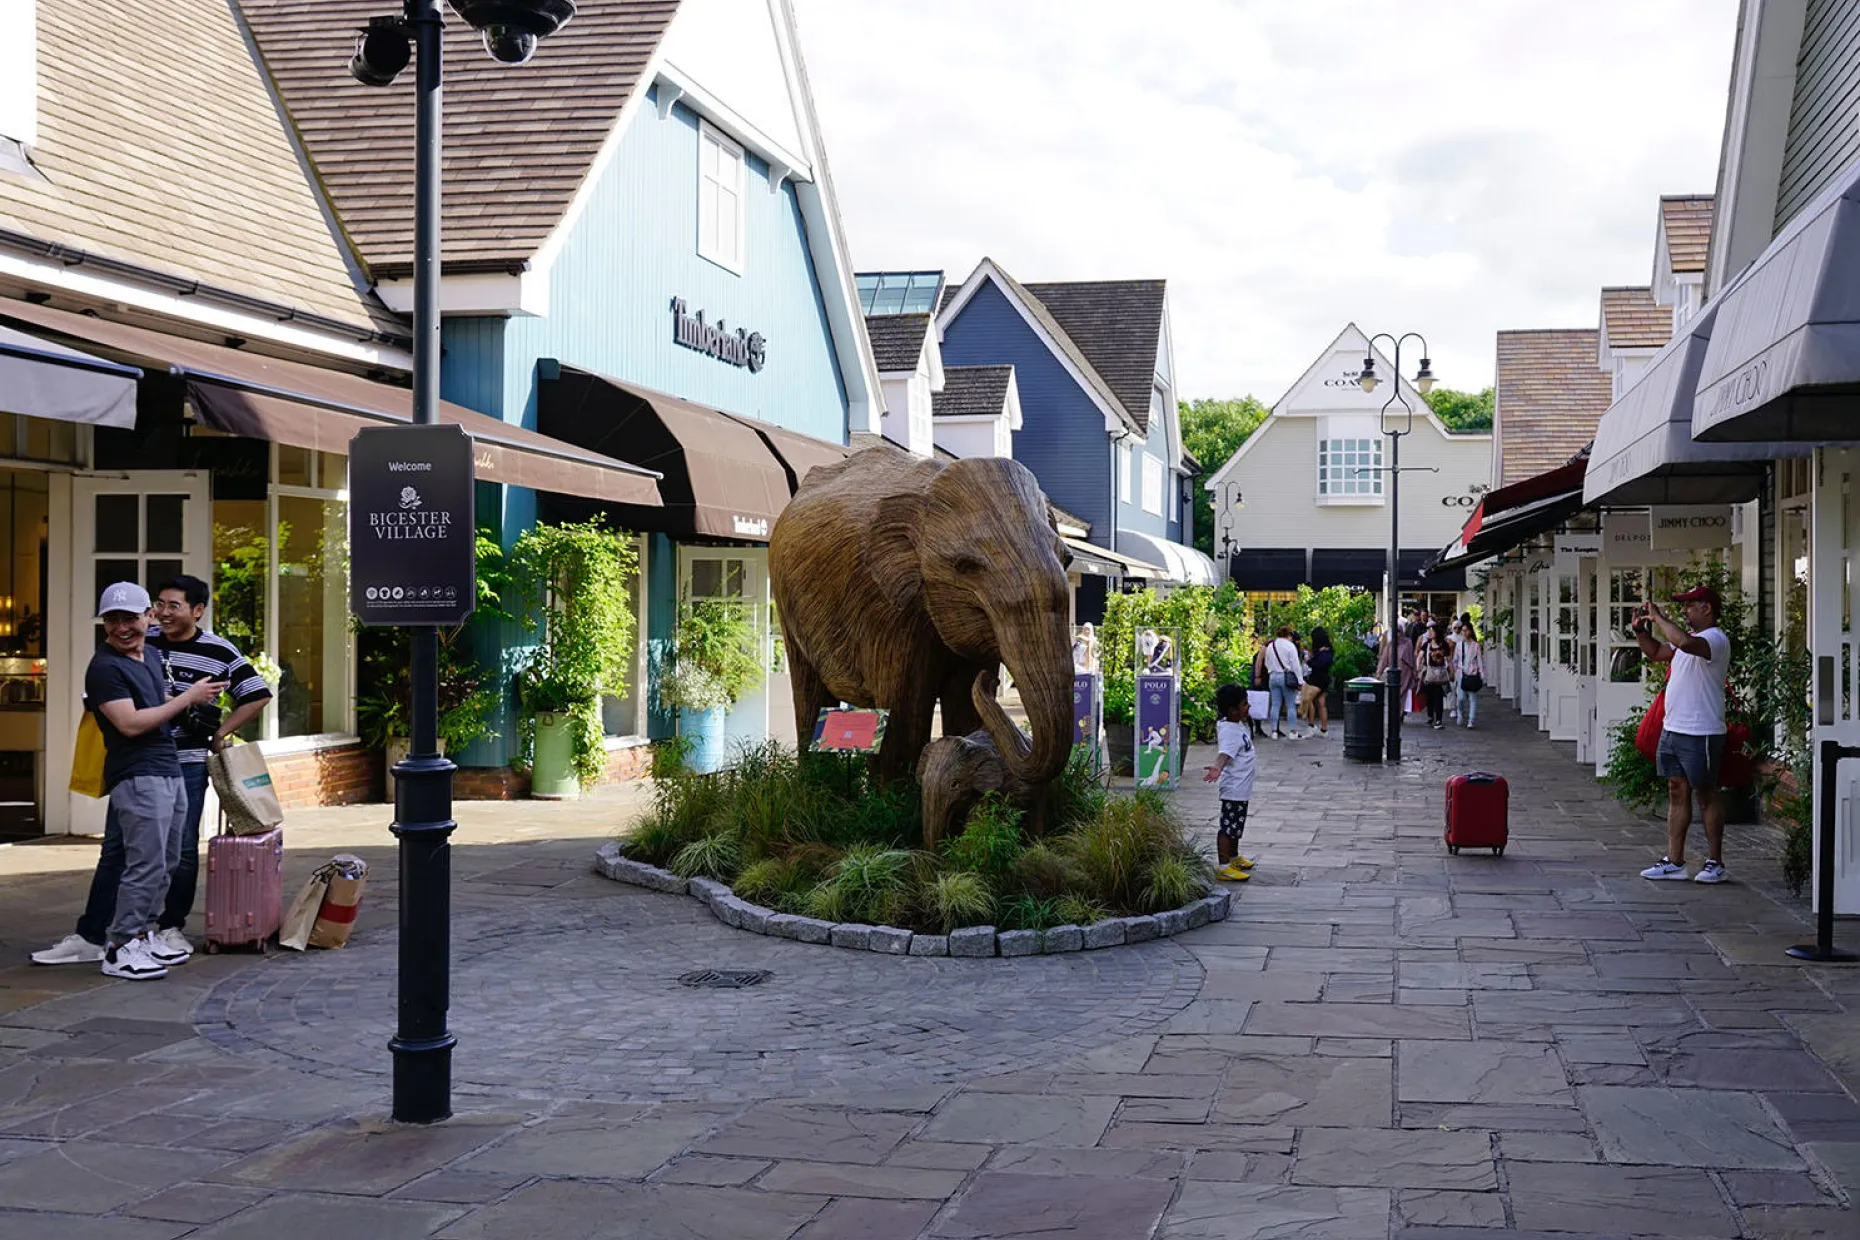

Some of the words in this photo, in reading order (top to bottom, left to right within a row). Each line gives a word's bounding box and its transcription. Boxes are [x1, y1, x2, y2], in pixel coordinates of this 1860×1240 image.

[669, 296, 747, 369] Timberland
[388, 462, 432, 472] Welcome
[370, 511, 451, 526] BICESTER
[1658, 516, 1687, 529] JIMMY
[1690, 515, 1726, 528] CHOO
[375, 525, 448, 539] VILLAGE
[1331, 585, 1364, 593] CACH
[1143, 681, 1168, 690] POLO
